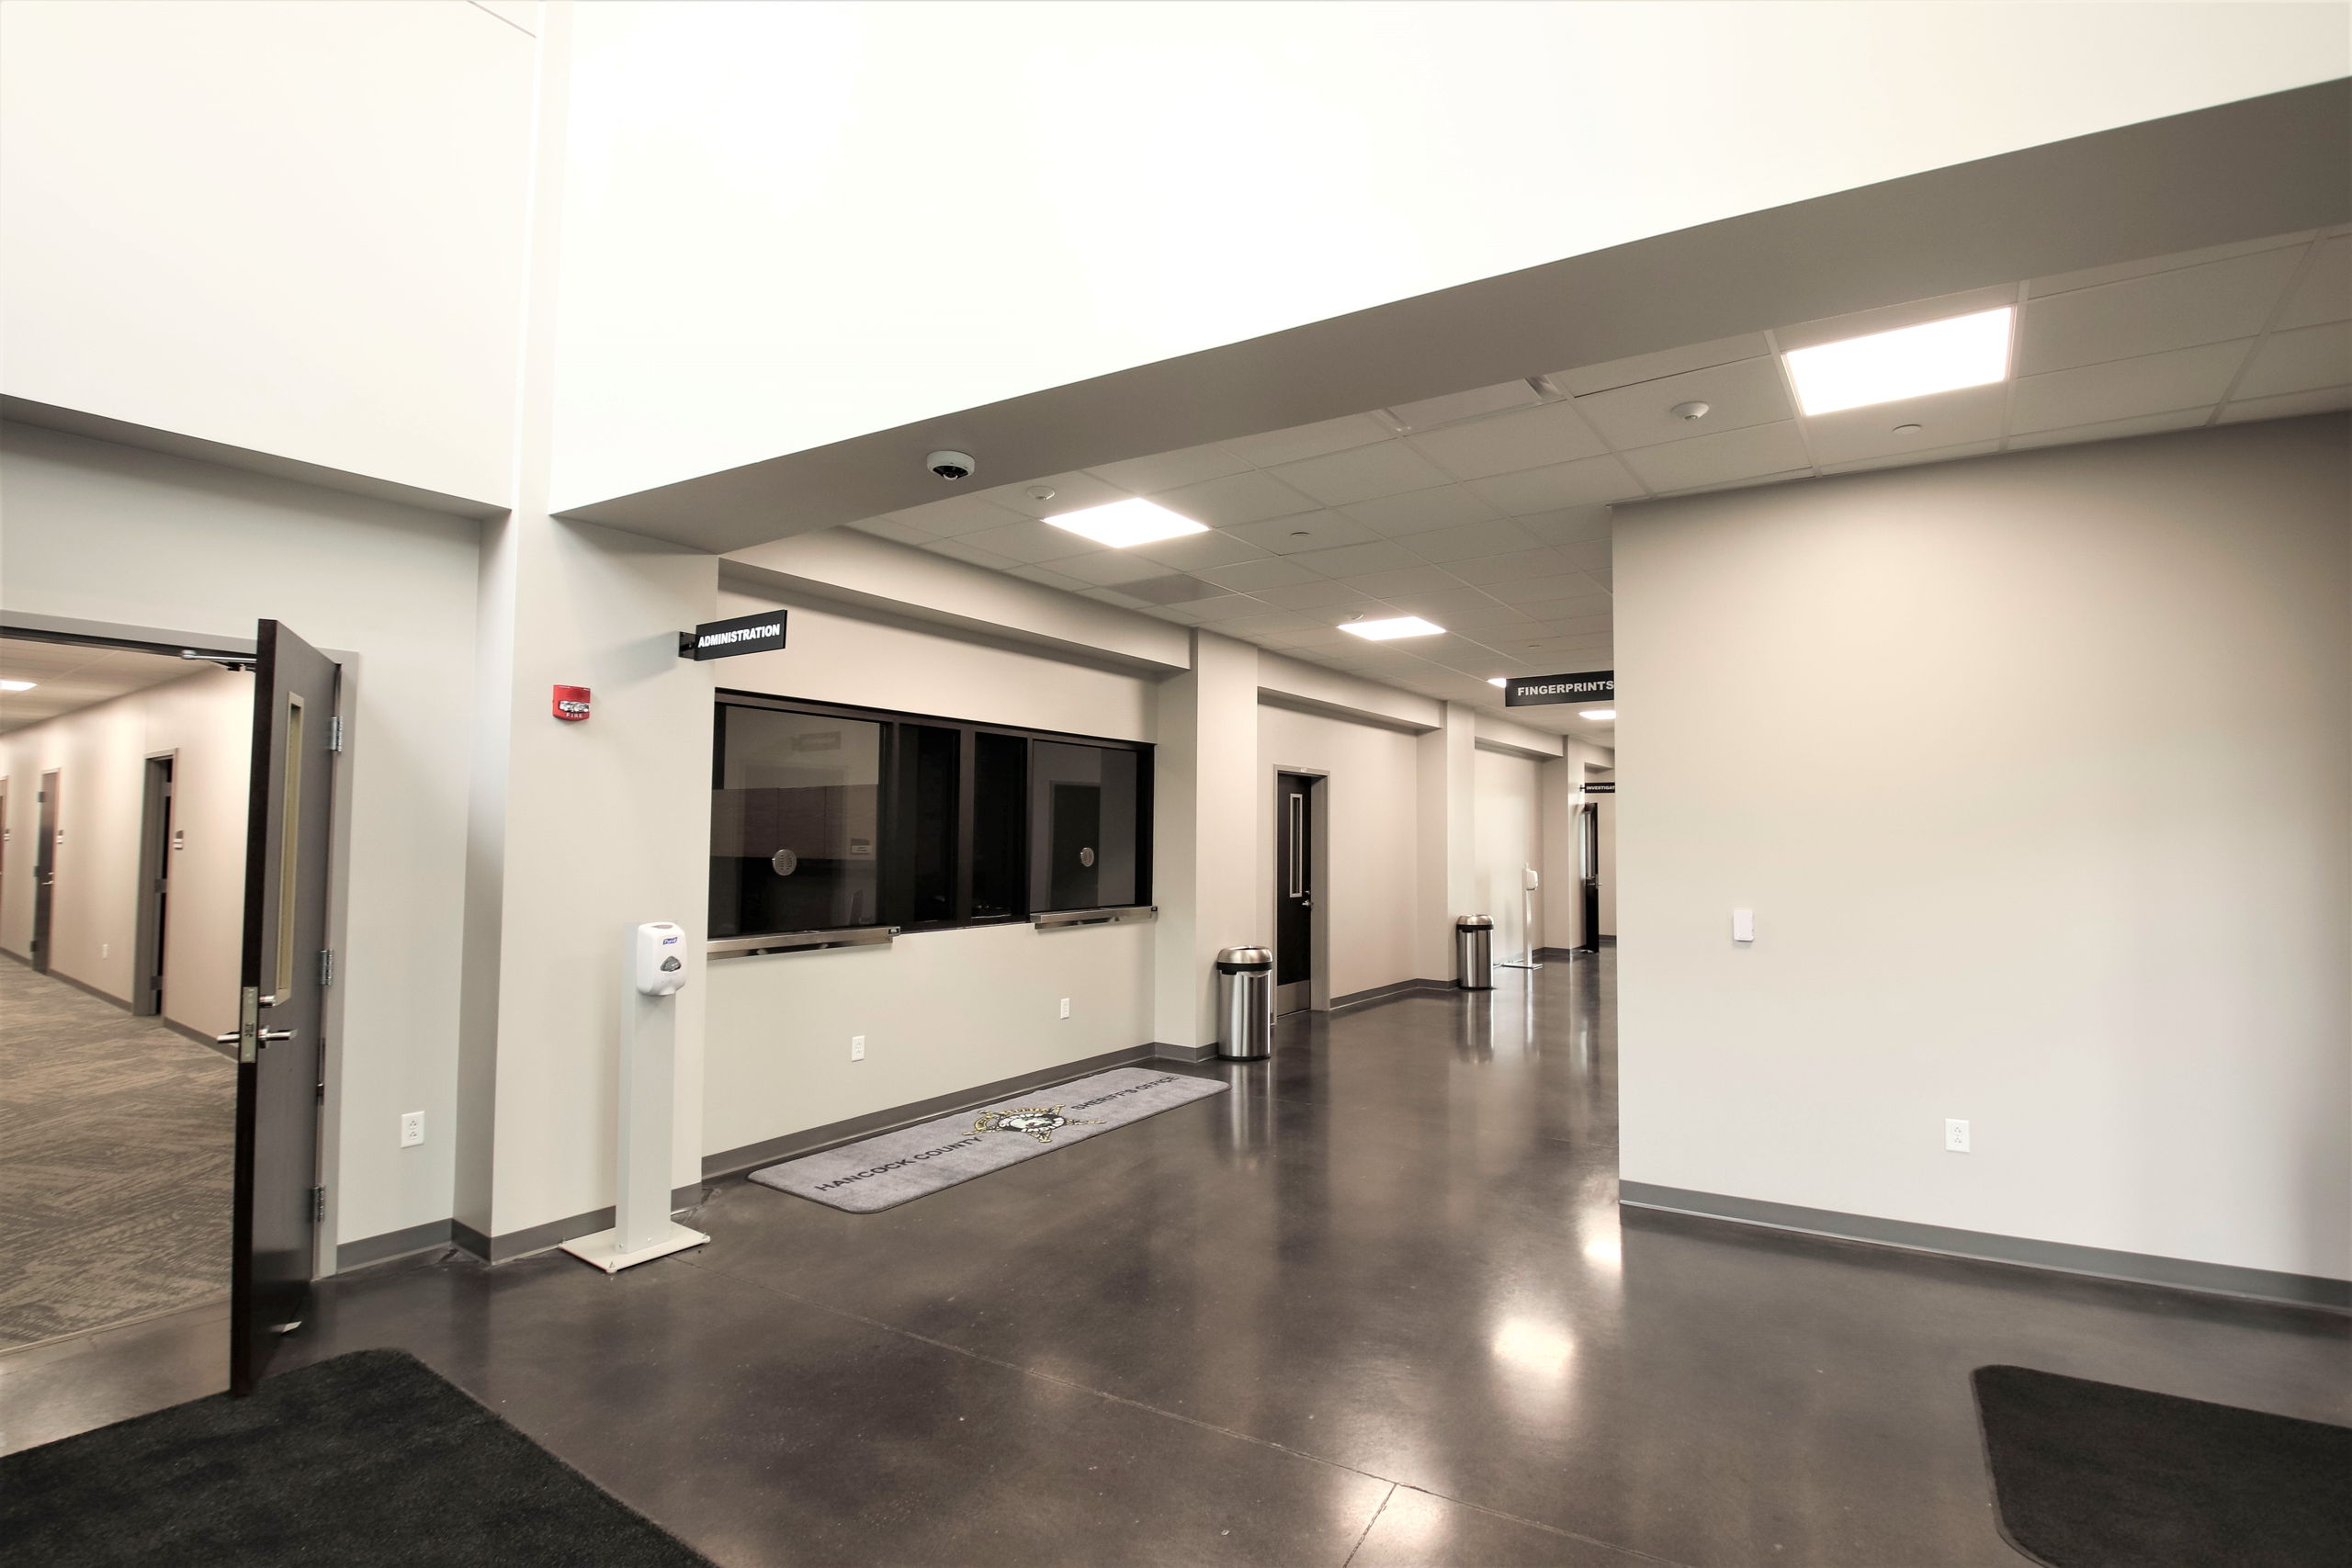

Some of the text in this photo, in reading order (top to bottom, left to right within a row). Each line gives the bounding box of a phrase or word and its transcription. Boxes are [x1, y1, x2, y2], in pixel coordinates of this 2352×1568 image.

[697, 624, 781, 649] ADMINISTRATION
[1517, 681, 1614, 696] FINGERPRINTS
[814, 1076, 1181, 1191] HANCOCK COUNTY SHERIFF'S OFFICE
